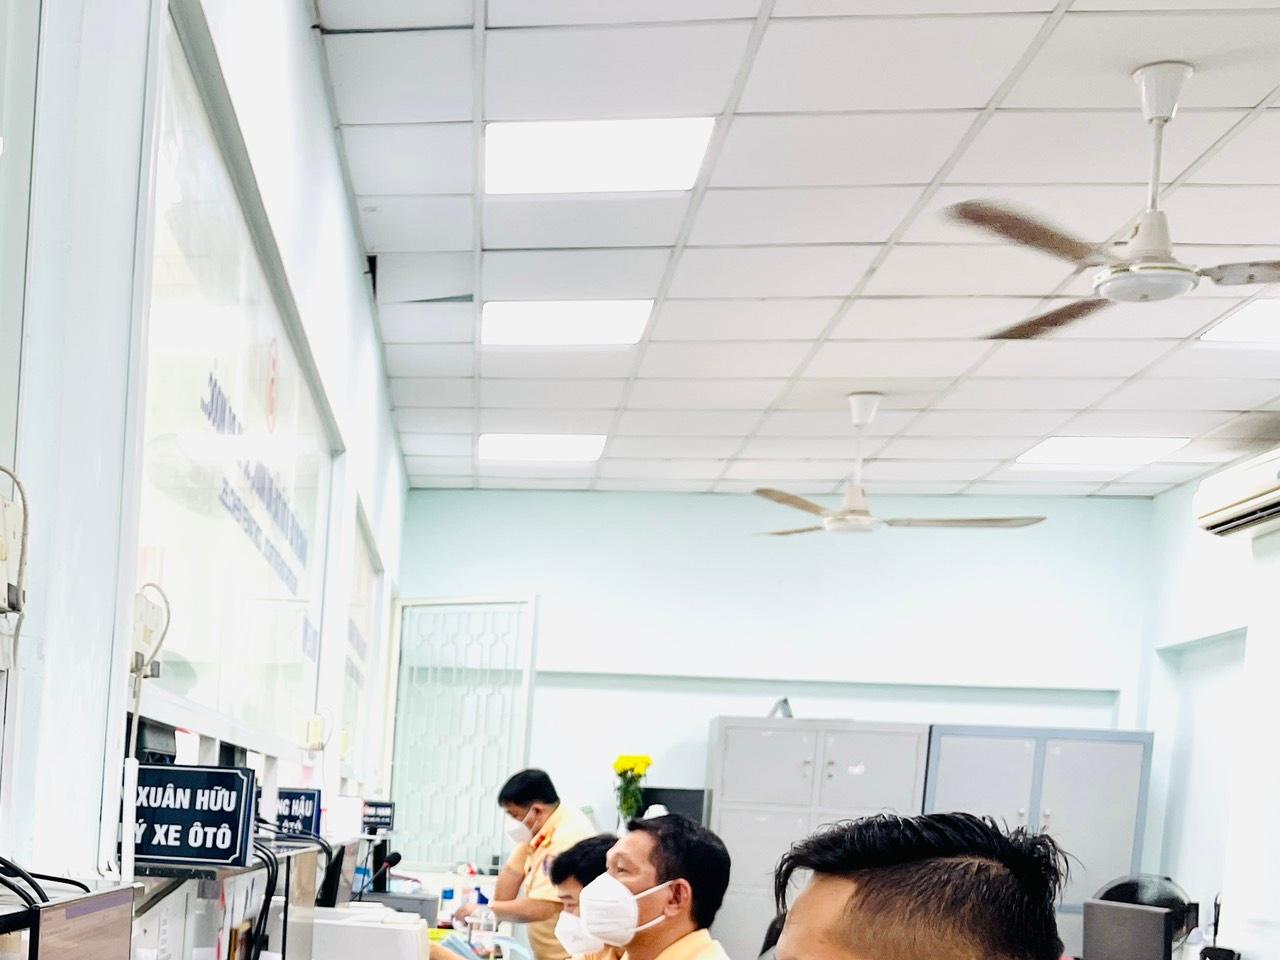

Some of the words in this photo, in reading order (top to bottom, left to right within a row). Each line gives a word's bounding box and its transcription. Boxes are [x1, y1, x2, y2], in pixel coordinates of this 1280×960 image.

[136, 783, 191, 810] XUÂN
[151, 823, 182, 847] XE
[187, 821, 232, 850] ÔTÔ
